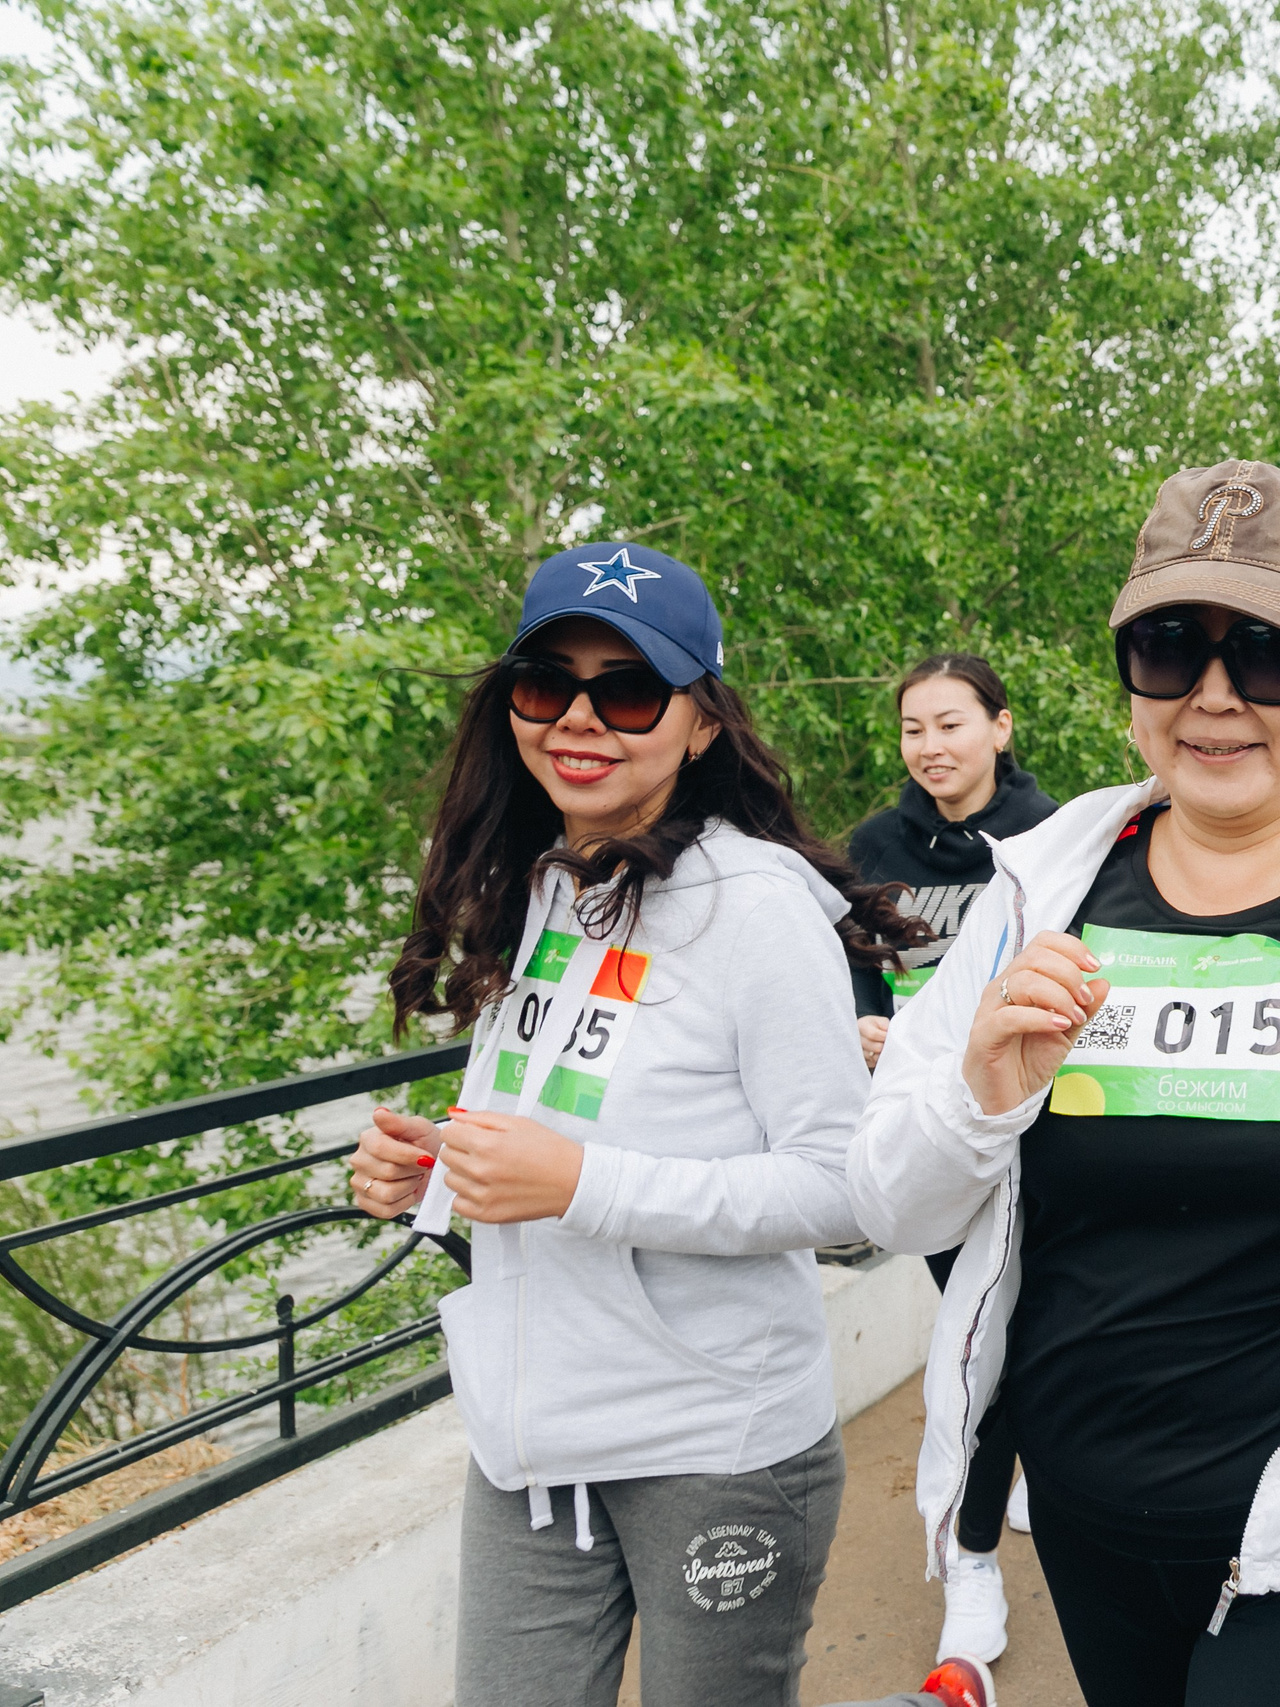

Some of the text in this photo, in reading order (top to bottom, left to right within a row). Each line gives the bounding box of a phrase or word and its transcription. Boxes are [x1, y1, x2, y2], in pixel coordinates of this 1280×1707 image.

[1190, 484, 1264, 552] P
[897, 883, 988, 936] NIK
[1118, 953, 1177, 966] СБЕРБАНК
[517, 992, 617, 1060] 05
[1158, 1074, 1247, 1099] бежим
[707, 1525, 755, 1540] LEGENDARY
[756, 1529, 777, 1549] TEAM
[685, 1552, 775, 1584] Sportswear
[687, 1586, 714, 1611] ITALIAN
[717, 1597, 745, 1612] BRAND
[721, 1577, 744, 1596] 67
